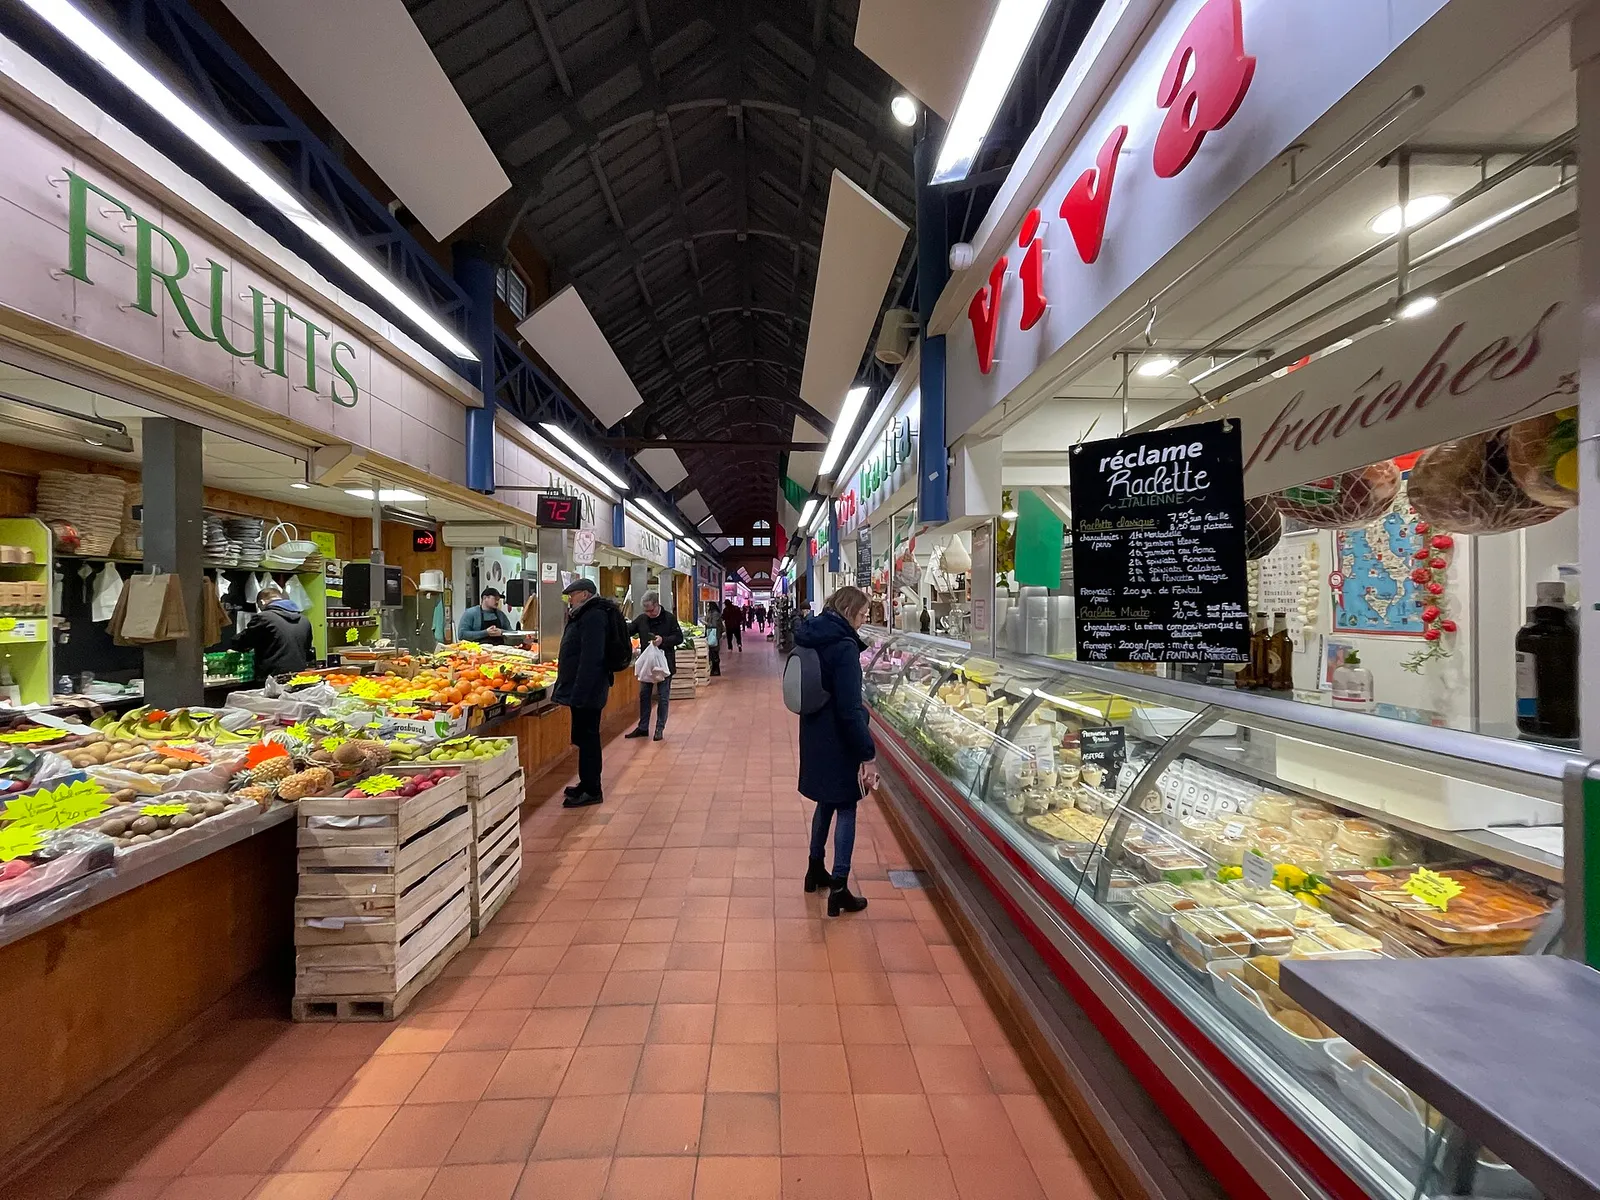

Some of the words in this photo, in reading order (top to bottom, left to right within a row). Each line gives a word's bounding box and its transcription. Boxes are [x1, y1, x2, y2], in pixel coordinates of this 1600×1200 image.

[968, 0, 1256, 374] viva
[61, 166, 359, 409] FRUITS
[1244, 300, 1562, 478] fraîches
[1099, 442, 1203, 473] réclame
[1106, 461, 1211, 498] Raclette
[546, 501, 572, 521] 72
[1117, 493, 1185, 509] ITALIENNE
